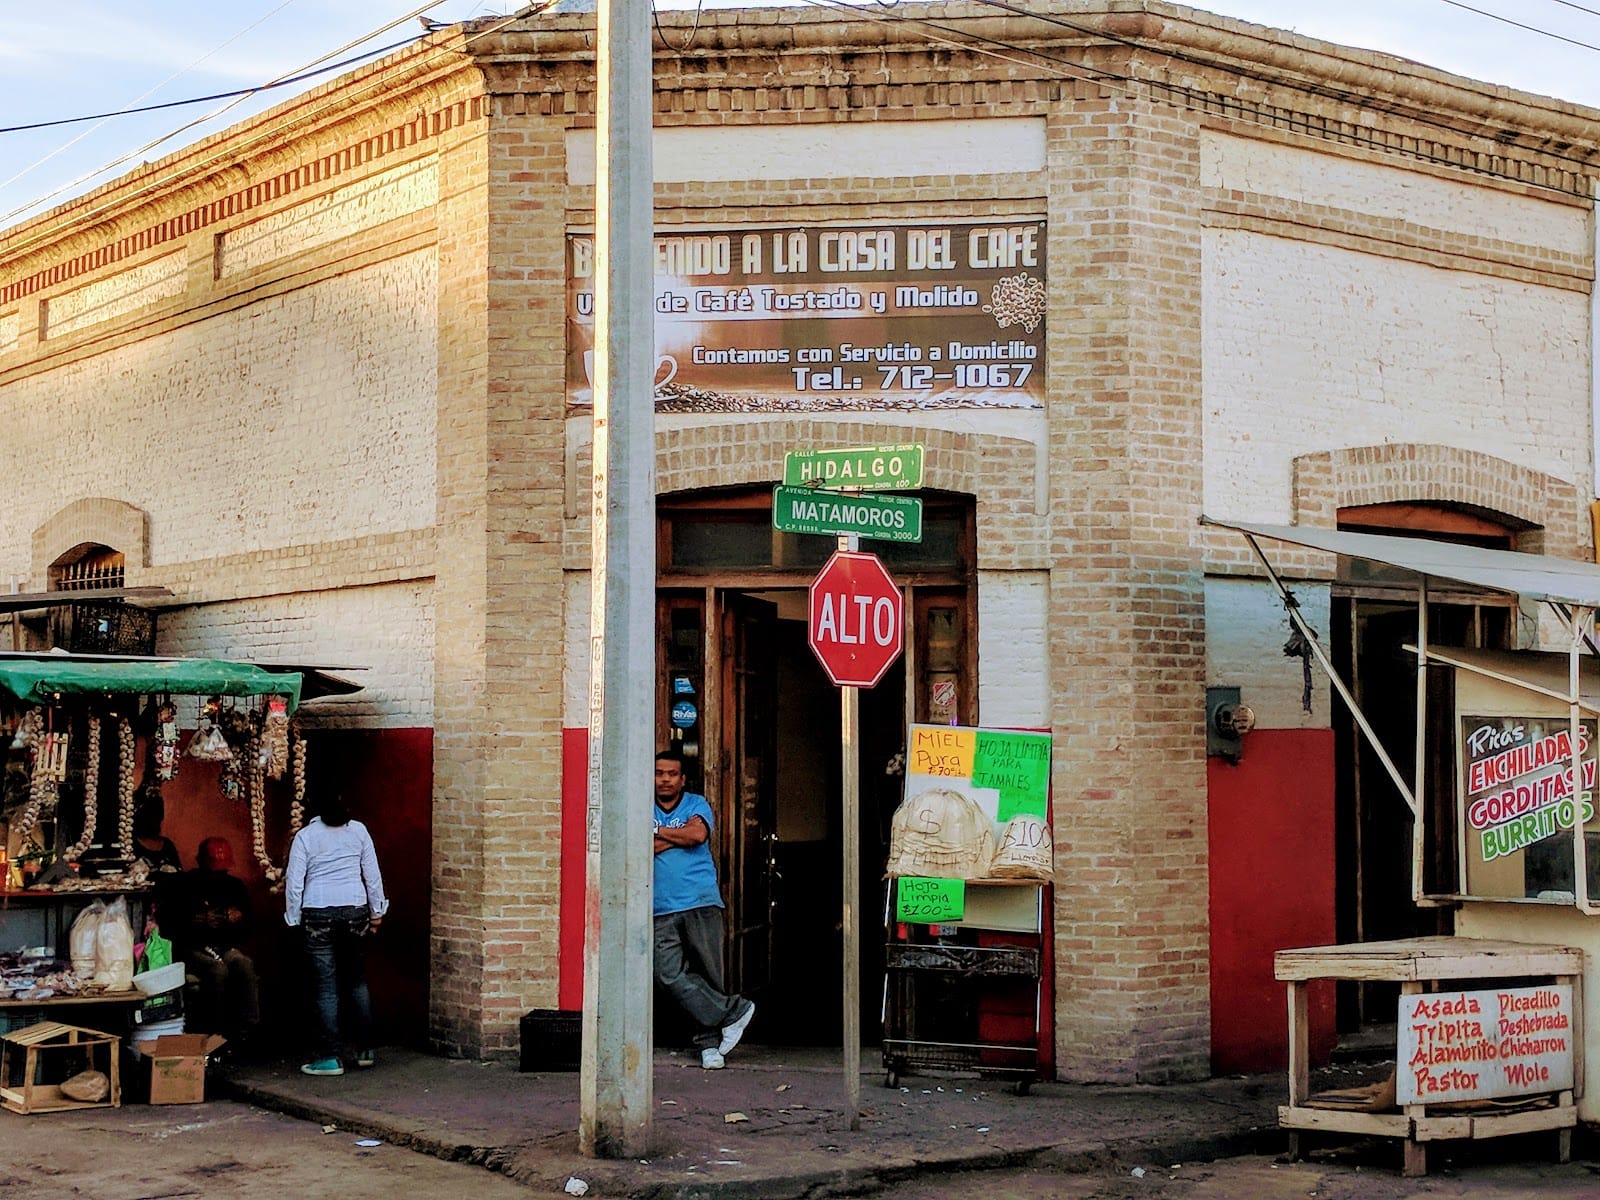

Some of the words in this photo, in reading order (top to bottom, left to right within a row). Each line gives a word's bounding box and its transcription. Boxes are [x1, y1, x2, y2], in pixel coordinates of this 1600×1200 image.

[573, 235, 730, 279] BENIDO
[742, 234, 761, 274] A
[773, 233, 808, 273] LA
[819, 231, 896, 271] CASA
[907, 229, 956, 270] DEL
[968, 226, 1038, 269] CAFE
[656, 292, 688, 313] de
[695, 287, 753, 312] Café
[762, 286, 862, 310] Tostado
[870, 291, 887, 313] y
[896, 285, 978, 308] Molido
[692, 345, 790, 364] Contamos
[796, 345, 833, 363] con
[839, 342, 922, 363] Servicio
[928, 346, 941, 361] a
[949, 340, 1037, 361] Domicilio
[792, 366, 862, 391] Tel.:
[877, 363, 1034, 390] 712-1067
[801, 456, 903, 481] HIDALGO
[785, 487, 812, 496] AVENIDA
[792, 500, 906, 529] MATAMOROS
[893, 531, 913, 540] 3000
[817, 592, 895, 647] ALTO
[979, 739, 1011, 757] HOJA
[1467, 725, 1524, 757] Ricas
[916, 750, 960, 767] Pura
[992, 758, 1022, 769] PARA
[979, 772, 1031, 791] TAMALES
[1583, 759, 1597, 789] Y
[1481, 791, 1595, 861] BURRITOS
[1412, 993, 1481, 1019] Asada
[1497, 991, 1560, 1017] Picadillo
[1412, 1019, 1483, 1045] Tripita
[1498, 1011, 1569, 1037] Deshebrada
[1408, 1038, 1497, 1067] Alambrito
[1499, 1037, 1566, 1059] Chicharron
[1414, 1067, 1480, 1097] Pastor
[1503, 1062, 1550, 1088] Mole
